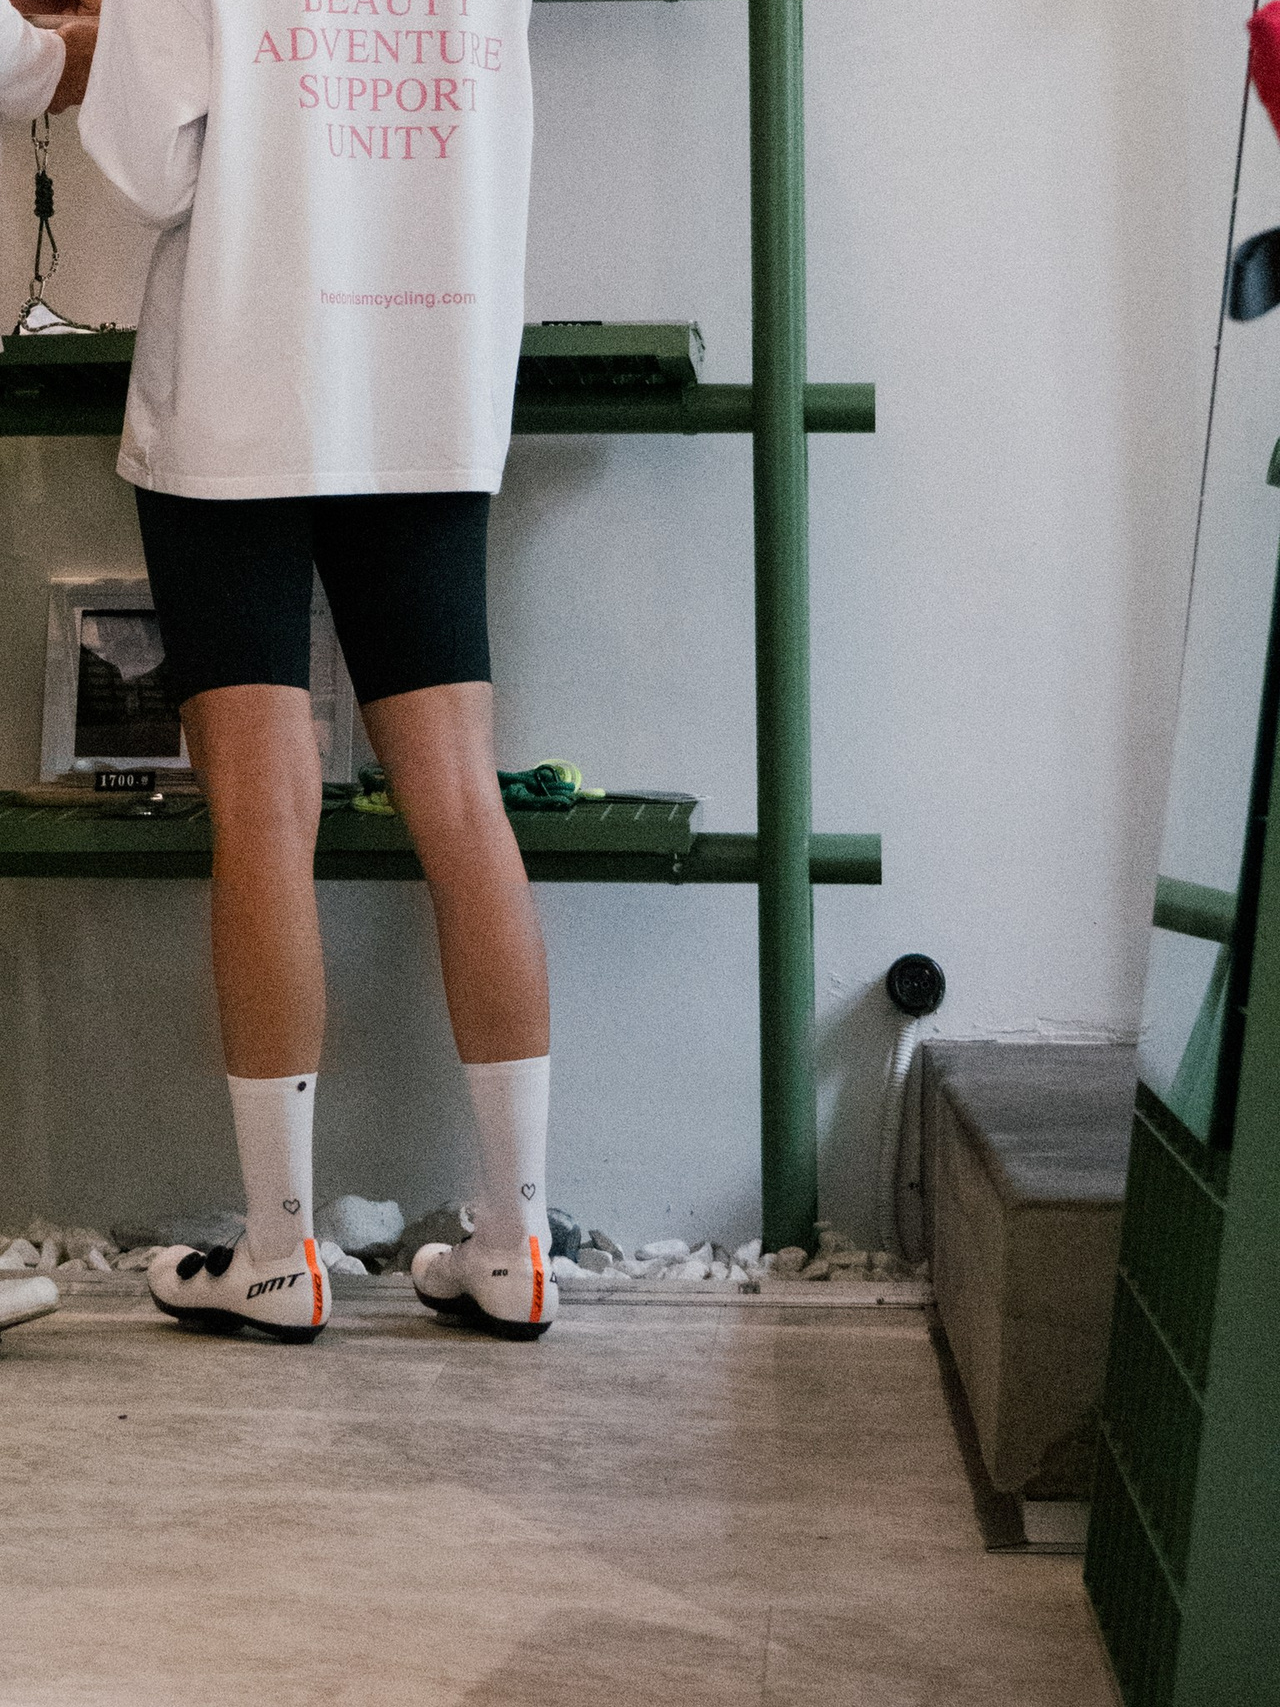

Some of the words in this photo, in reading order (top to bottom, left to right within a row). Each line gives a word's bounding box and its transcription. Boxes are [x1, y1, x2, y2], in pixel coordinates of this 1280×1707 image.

[252, 26, 503, 72] ADVENTURE
[298, 73, 478, 113] SUPPORT
[326, 124, 460, 160] UNITY
[246, 1271, 306, 1300] DMT
